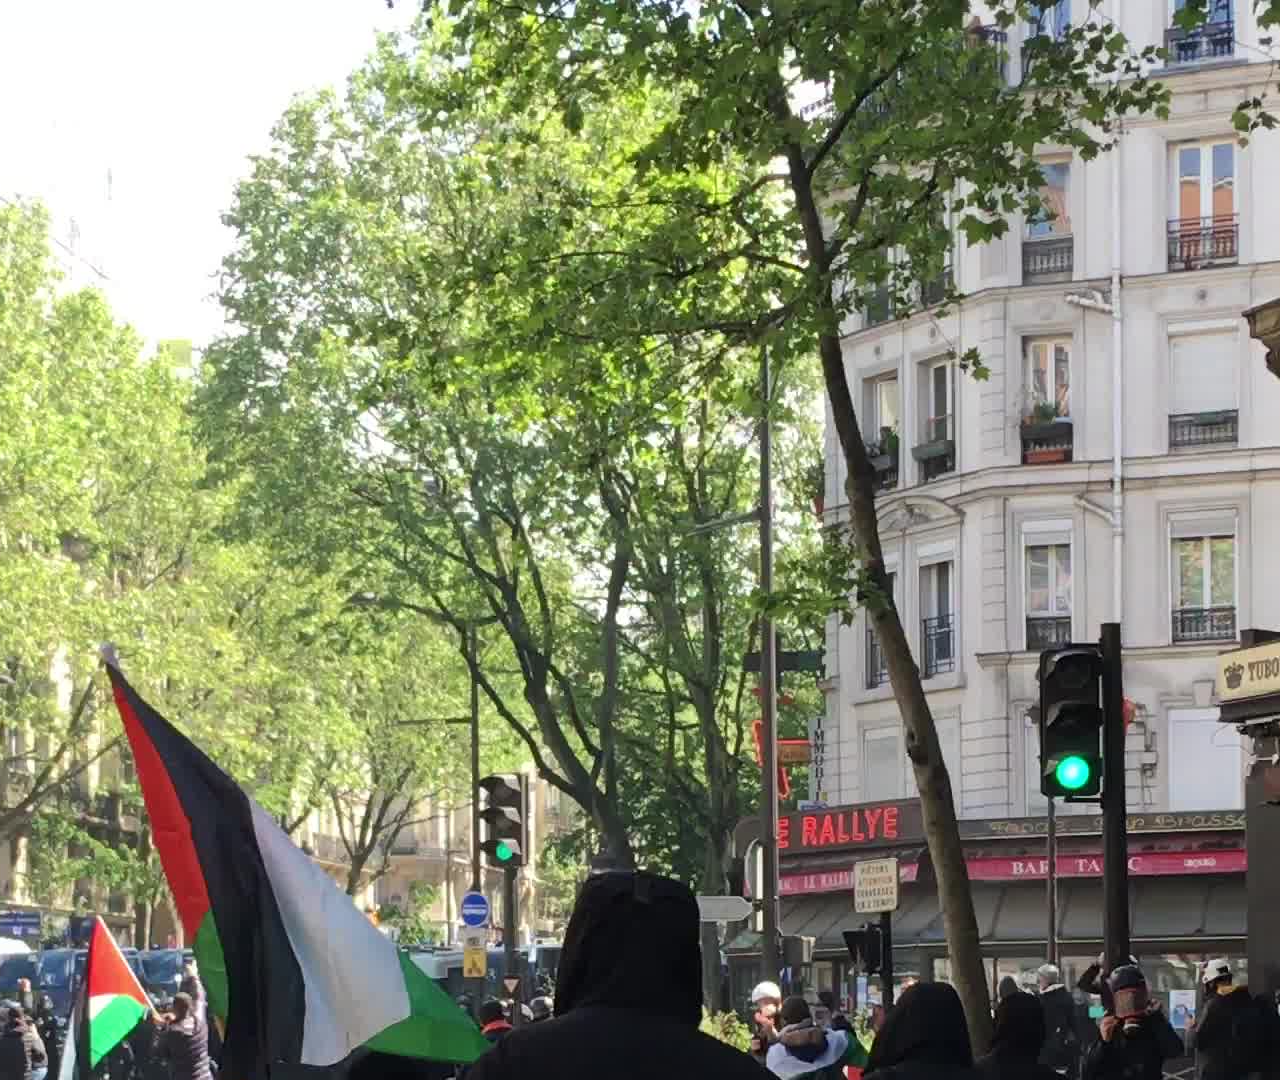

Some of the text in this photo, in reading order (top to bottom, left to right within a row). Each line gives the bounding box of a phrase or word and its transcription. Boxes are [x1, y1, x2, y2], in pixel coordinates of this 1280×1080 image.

[777, 807, 898, 848] E RALLYE
[1075, 856, 1143, 873] TAC
